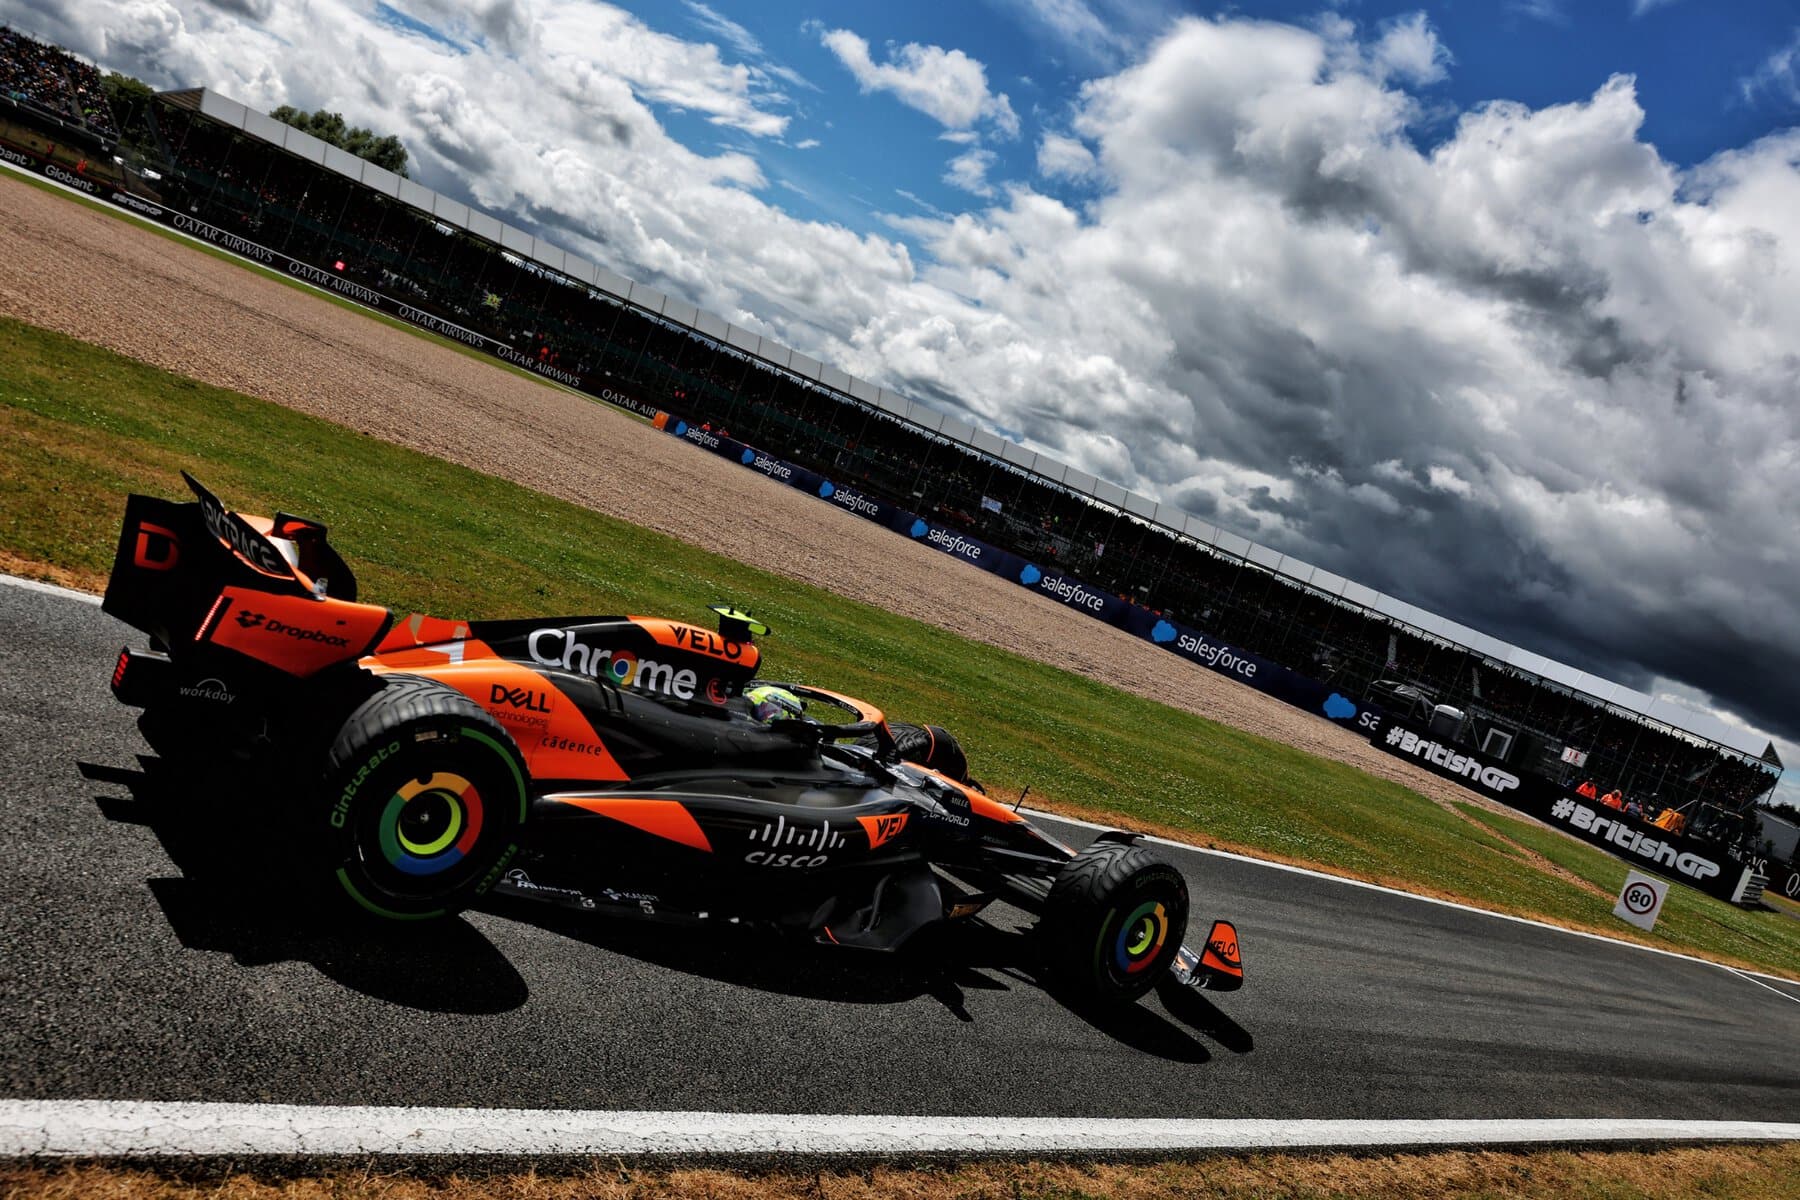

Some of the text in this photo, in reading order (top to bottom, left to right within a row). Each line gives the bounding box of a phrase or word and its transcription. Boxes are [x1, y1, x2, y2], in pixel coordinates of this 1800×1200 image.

[45, 164, 93, 192] Globant
[173, 214, 274, 263] QATAR AIRWAYS
[288, 262, 381, 305] QATAR AIRWAYS
[398, 306, 484, 347] QATAR AIRWAYS
[497, 346, 581, 386] QATAR AIRWAYS
[602, 389, 638, 410] QATAR
[686, 427, 719, 448] salesforce
[753, 455, 792, 479] salesforce
[833, 488, 879, 516] salesforce
[927, 527, 981, 559] salesforce
[1041, 575, 1104, 612] salesforce
[265, 619, 349, 648] Dropbox
[668, 623, 742, 660] VELO
[528, 628, 697, 700] Chrome
[1177, 633, 1257, 678] salesforce
[179, 681, 236, 704] workday
[490, 684, 551, 714] DELL
[1385, 725, 1521, 793] #BritishGP
[1551, 797, 1721, 880] #BritishGP
[1628, 890, 1651, 908] 80
